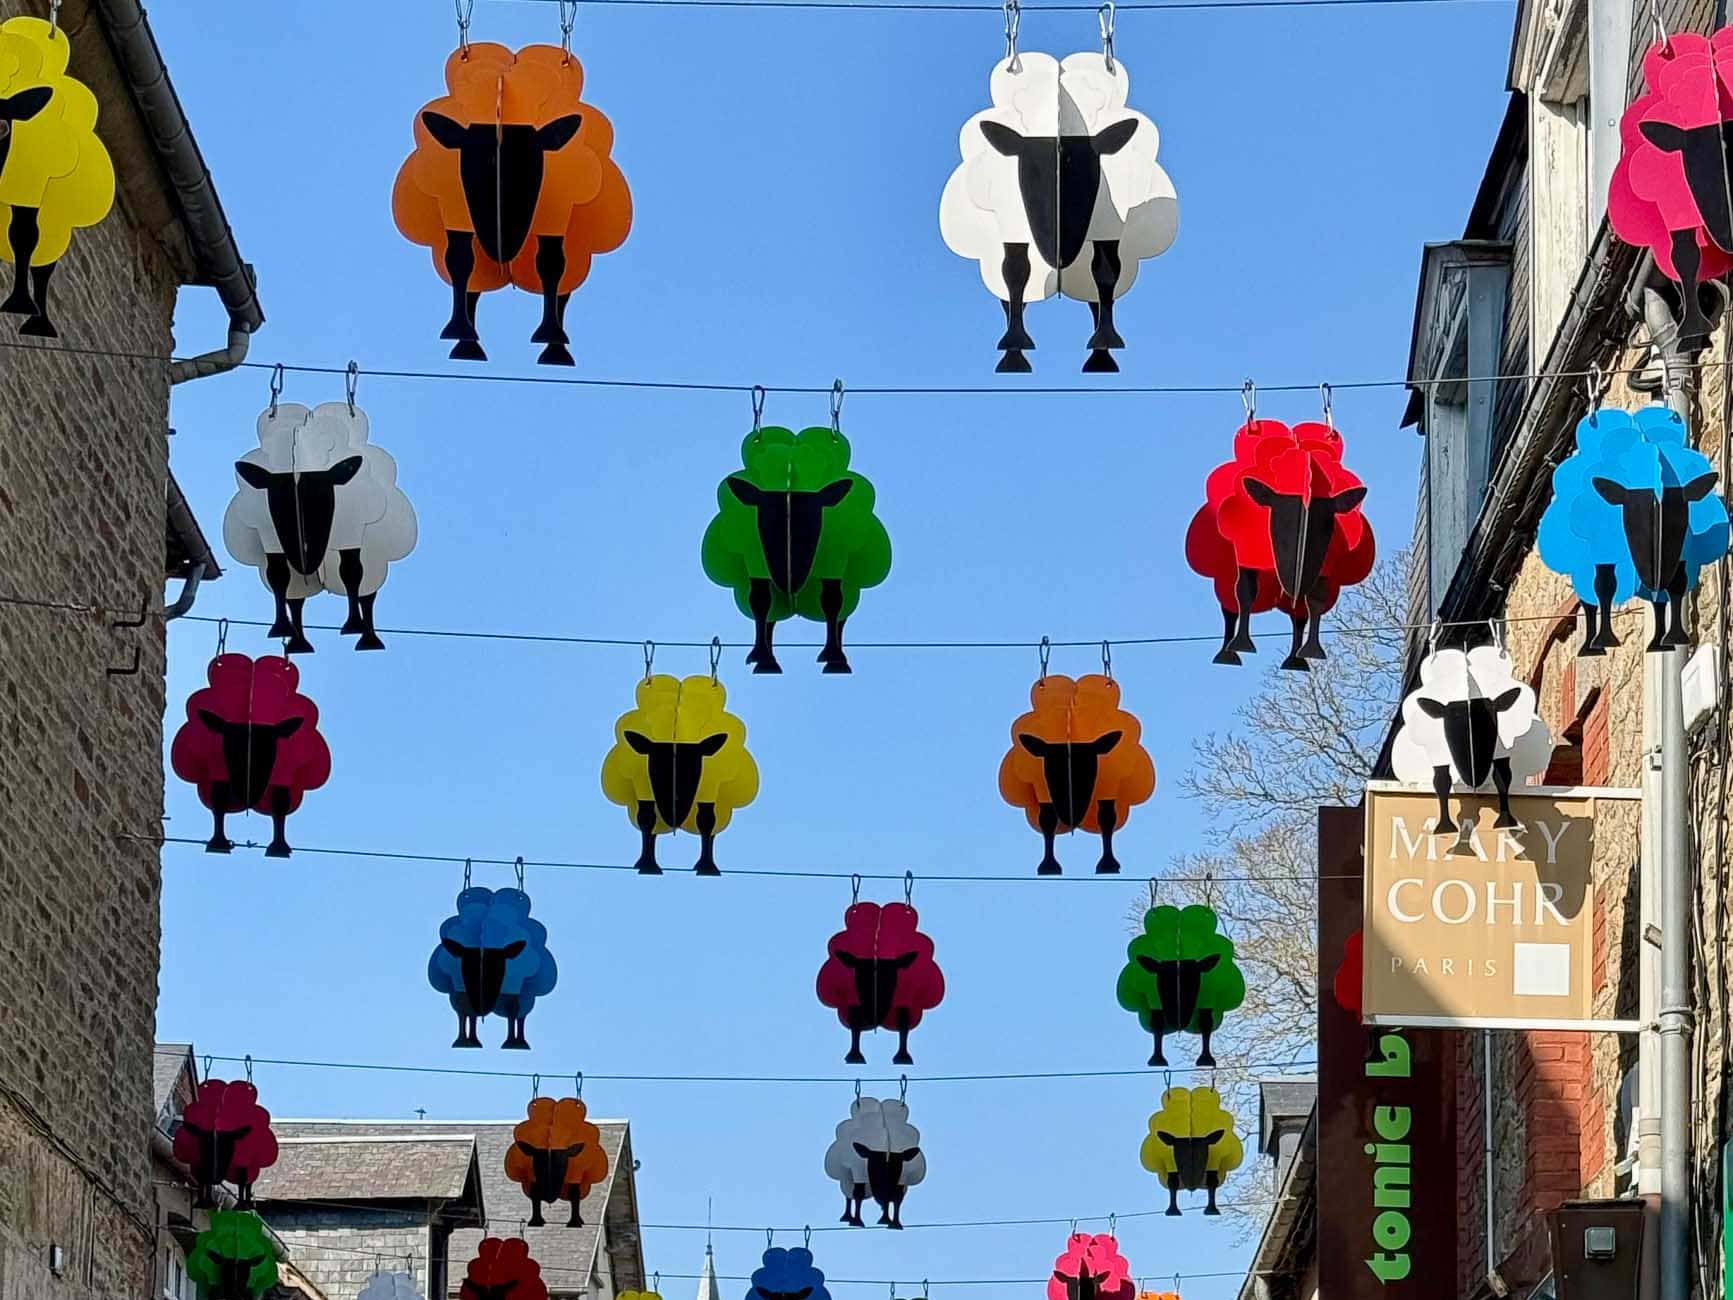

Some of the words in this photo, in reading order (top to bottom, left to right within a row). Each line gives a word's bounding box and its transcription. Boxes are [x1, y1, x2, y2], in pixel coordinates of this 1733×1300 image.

[1389, 816, 1571, 864] MARY
[1387, 878, 1571, 926] COHR
[1391, 957, 1498, 977] PARIS
[1364, 1104, 1412, 1286] tonic
